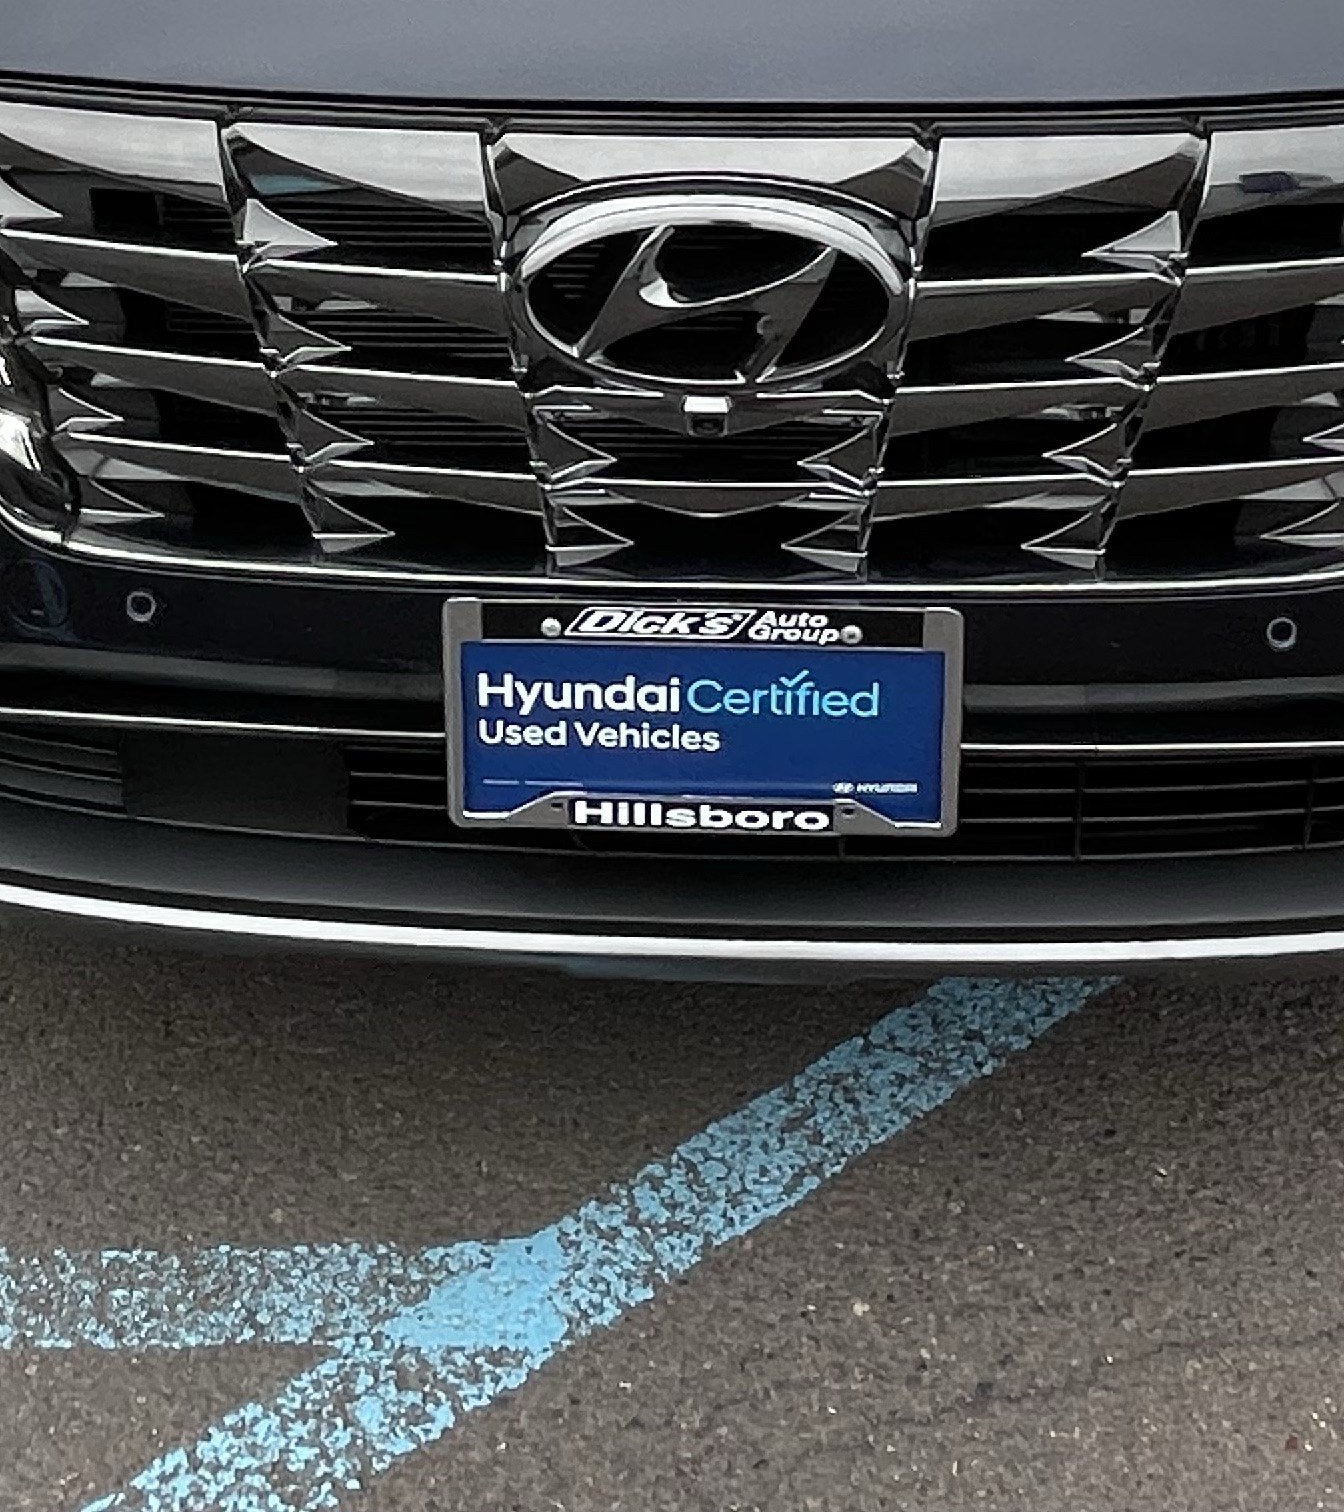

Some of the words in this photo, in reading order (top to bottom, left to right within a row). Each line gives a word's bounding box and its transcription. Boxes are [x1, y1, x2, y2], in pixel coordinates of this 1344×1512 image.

[752, 609, 830, 628] Auto
[748, 624, 841, 646] Group
[476, 671, 681, 716] Hyundai
[686, 674, 881, 718] Certified
[478, 719, 568, 747] Used
[573, 720, 721, 753] Vehicles
[573, 799, 831, 830] Hillsboro
